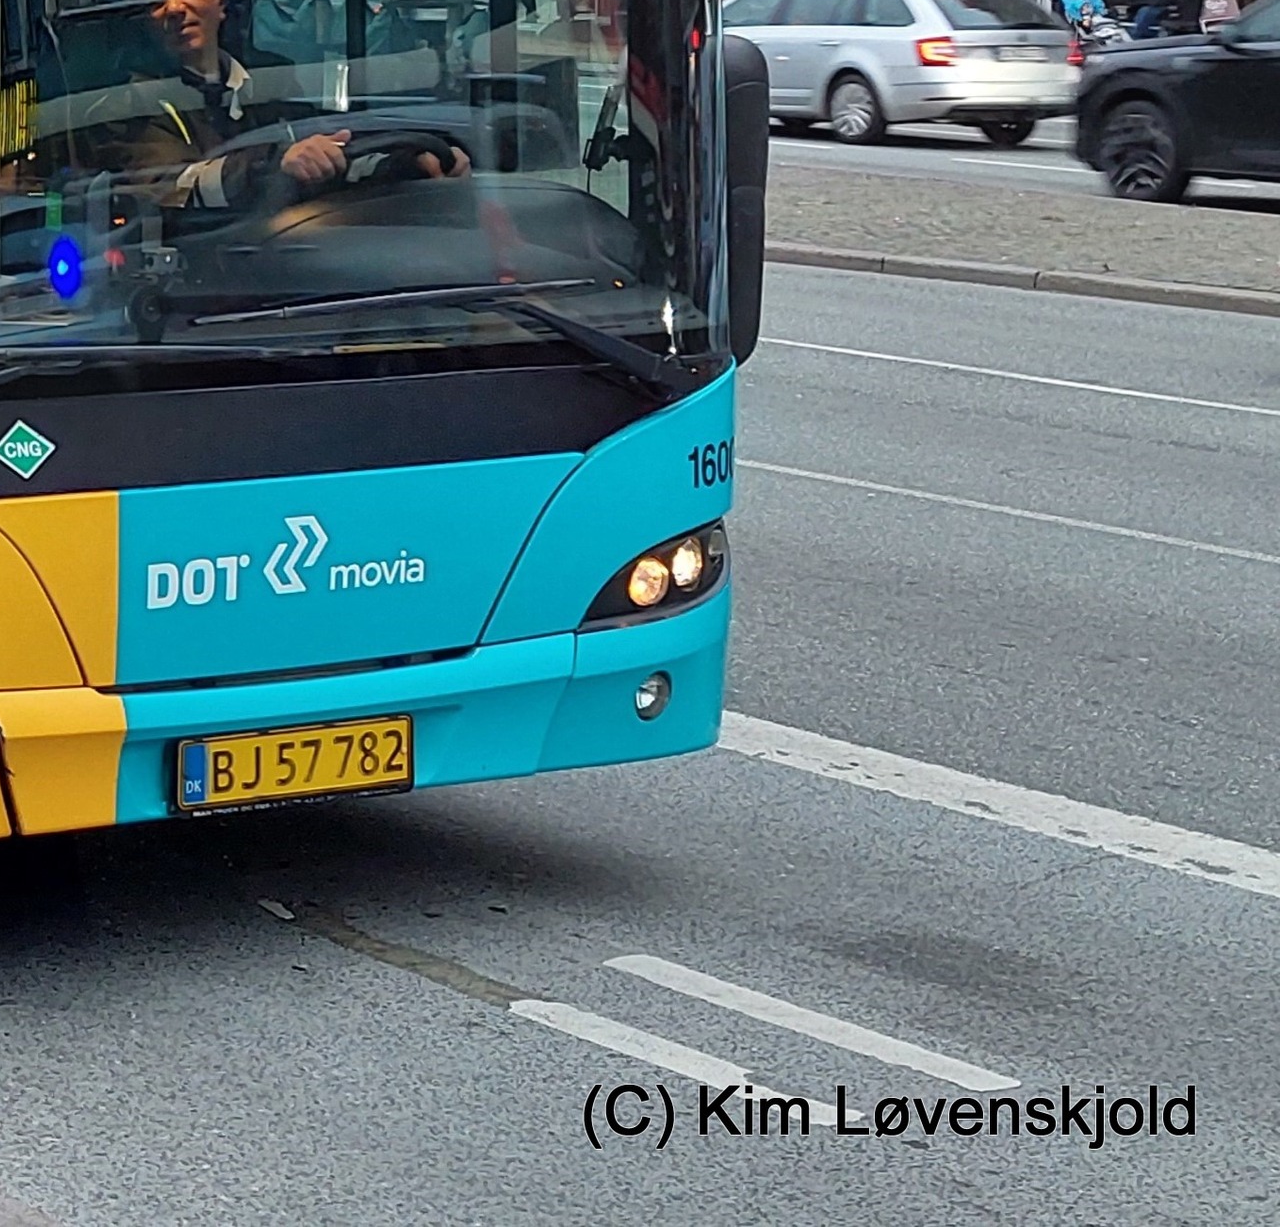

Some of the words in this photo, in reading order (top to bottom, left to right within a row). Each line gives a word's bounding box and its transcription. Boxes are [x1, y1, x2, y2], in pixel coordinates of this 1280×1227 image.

[3, 439, 41, 459] CNG
[147, 554, 250, 609] DOT
[329, 549, 424, 591] movia
[185, 779, 202, 794] DK
[211, 745, 262, 794] BJ
[275, 738, 323, 787] 57
[333, 729, 404, 779] 782
